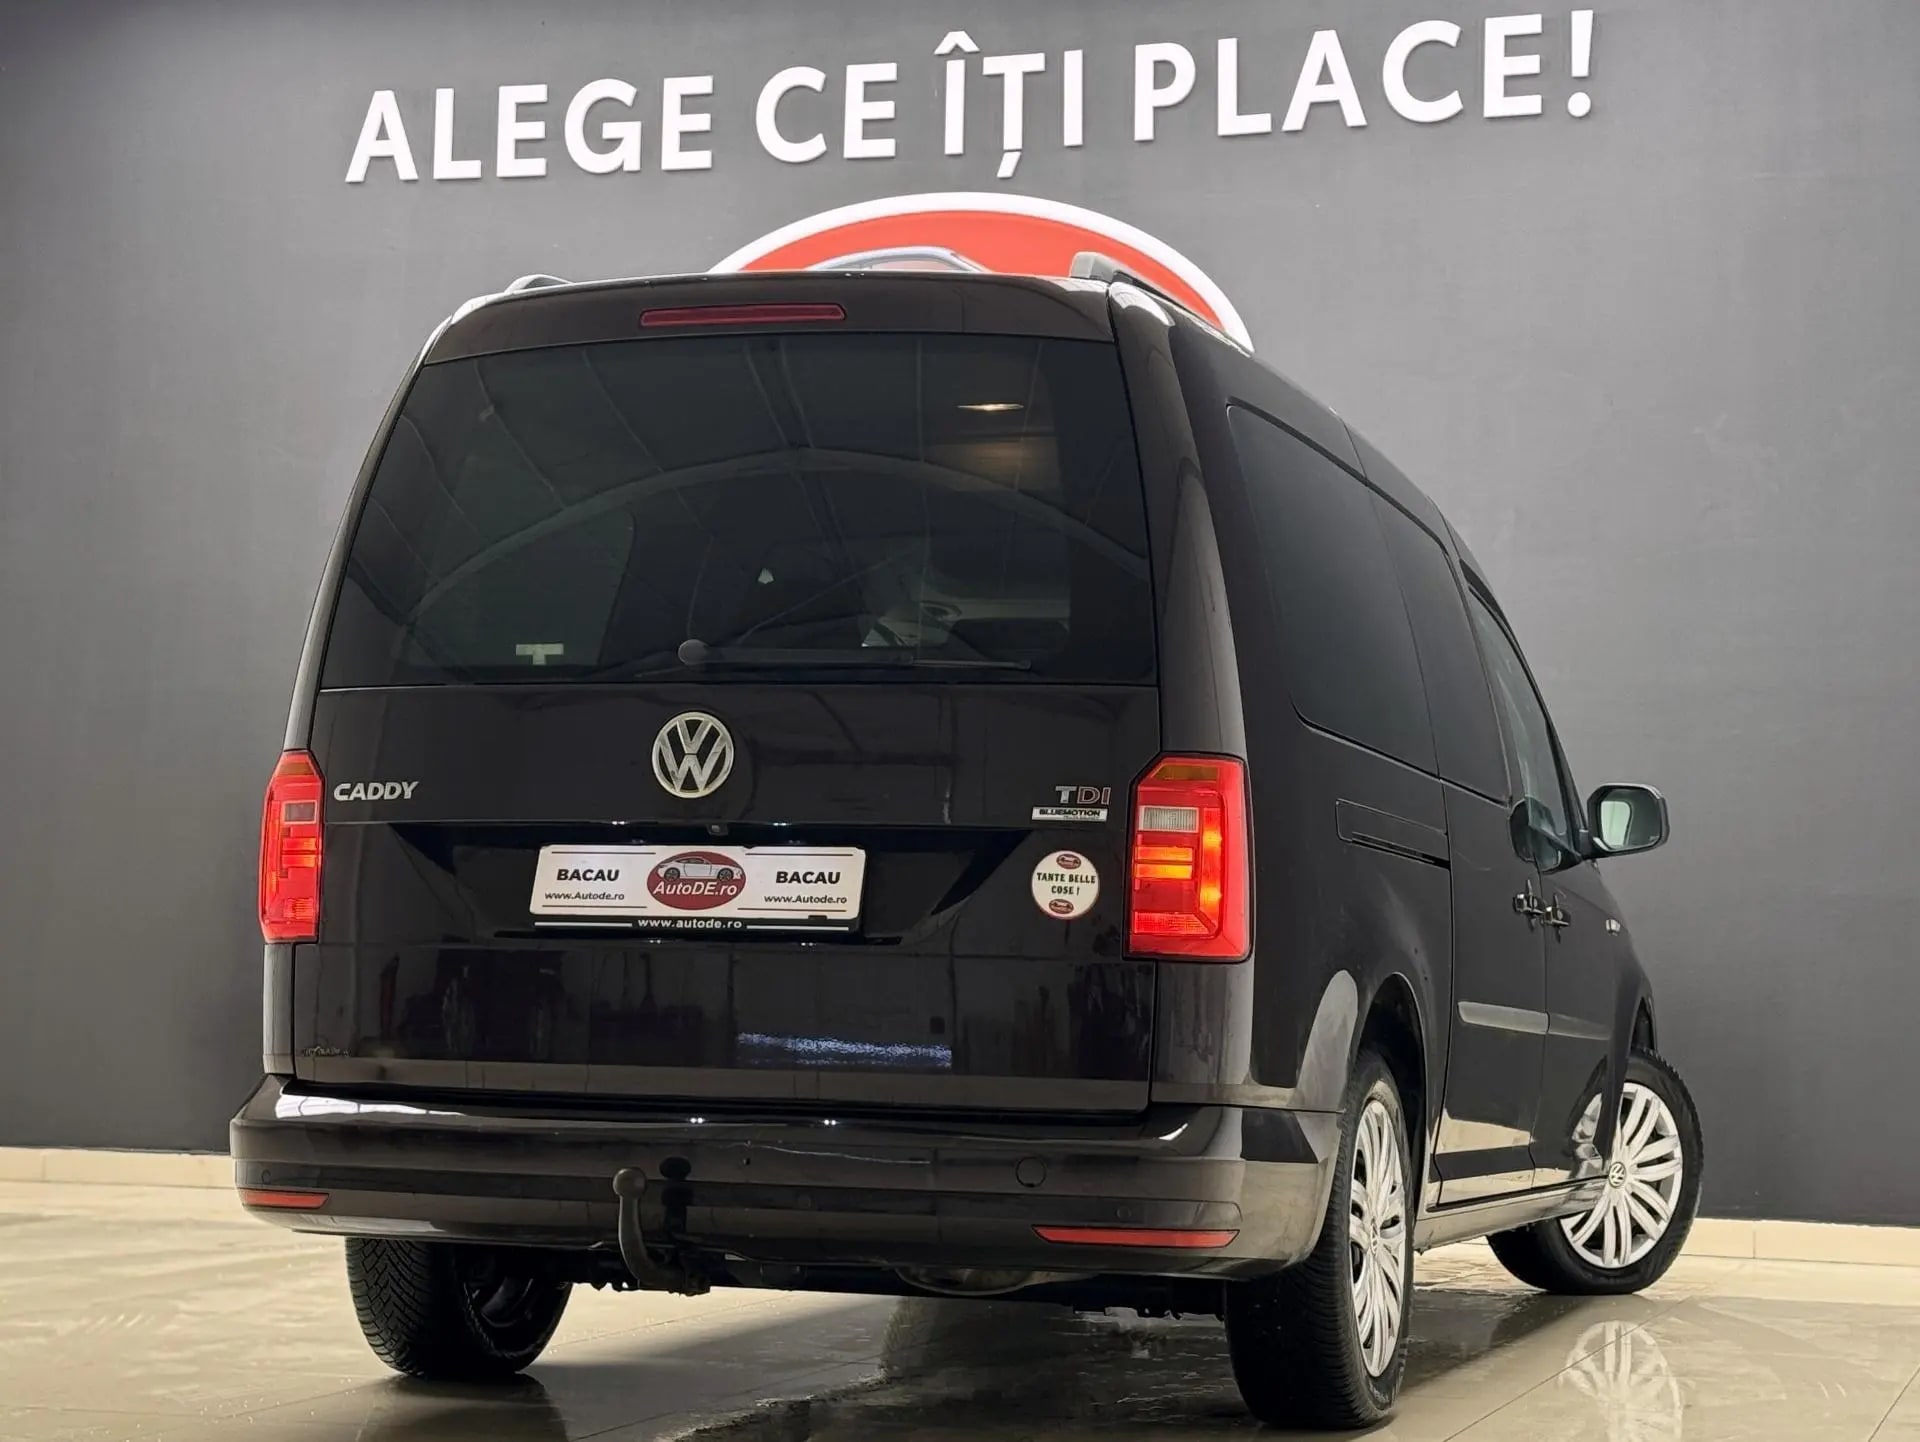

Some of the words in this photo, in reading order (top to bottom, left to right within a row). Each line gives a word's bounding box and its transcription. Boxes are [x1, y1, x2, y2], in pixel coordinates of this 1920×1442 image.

[345, 76, 714, 183] ALEGE
[755, 63, 898, 163] CE
[934, 31, 1084, 178] ÎȚI
[1134, 9, 1594, 141] PLACE!
[652, 712, 735, 799] VW
[334, 781, 419, 802] CADDY
[1055, 785, 1112, 805] TDI
[1039, 808, 1101, 817] BLUEMOTION
[557, 869, 620, 882] BACAU
[775, 871, 841, 884] BACAU
[1036, 872, 1065, 882] TANTE
[1068, 873, 1096, 884] BELLE
[652, 880, 738, 897] AutoDE.ro
[1051, 885, 1074, 895] COSE
[544, 891, 625, 901] www.Autode.ro
[763, 894, 847, 905] www.Autode.ro
[638, 918, 743, 929] www.autode.ro
